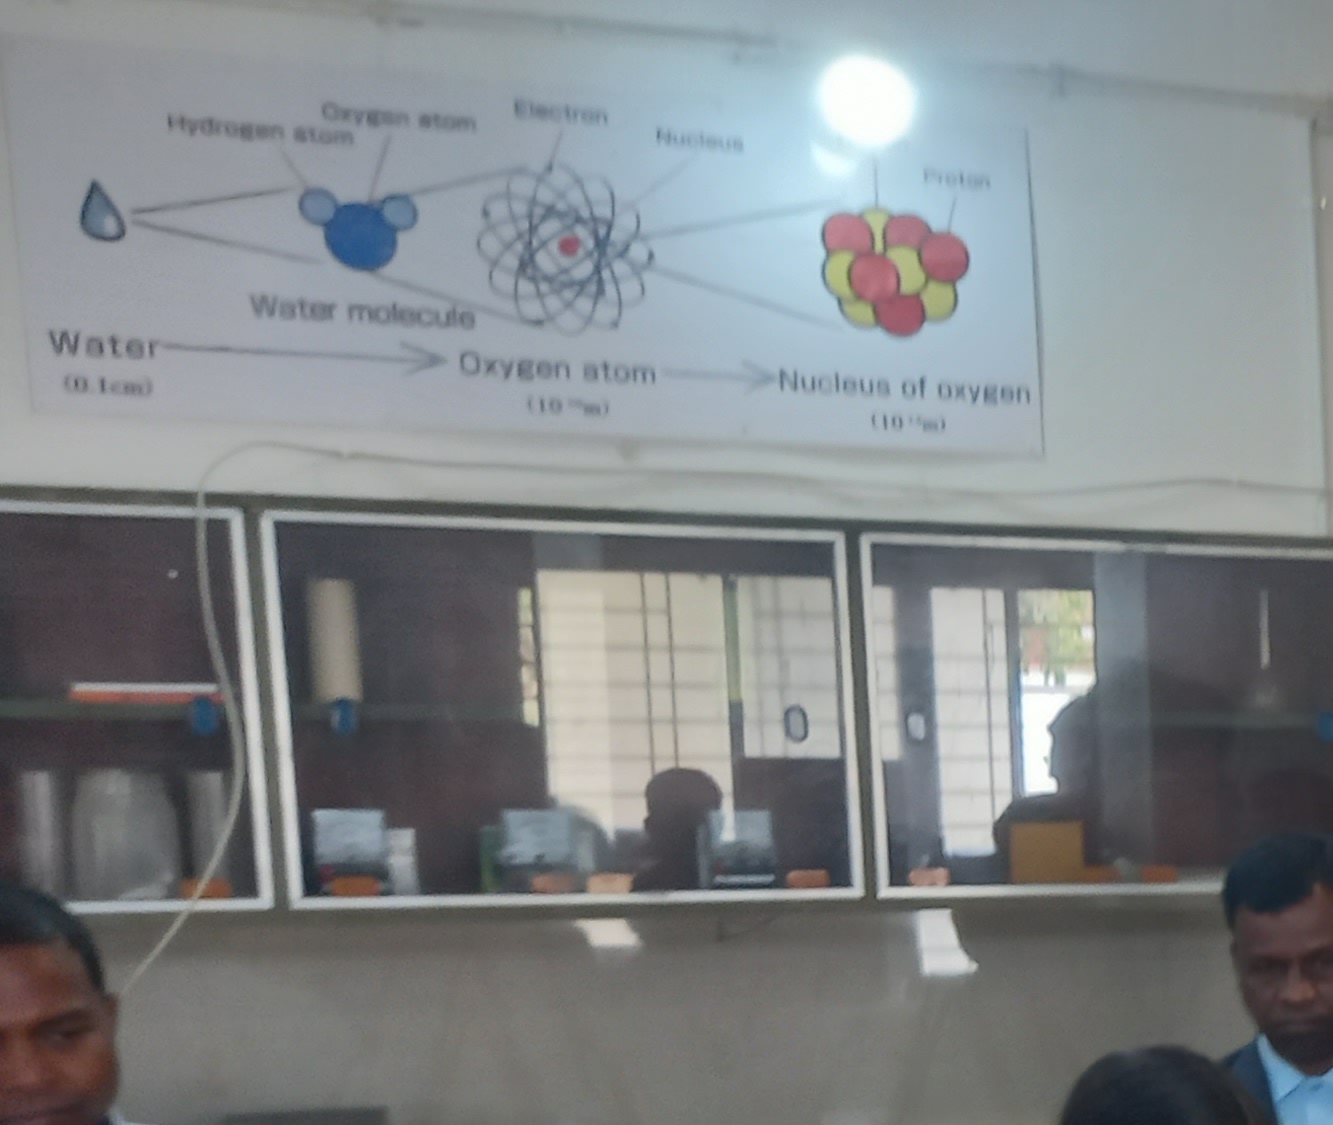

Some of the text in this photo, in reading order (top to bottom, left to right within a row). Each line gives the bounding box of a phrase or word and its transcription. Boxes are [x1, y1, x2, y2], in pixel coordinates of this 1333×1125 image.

[167, 112, 354, 145] Hydrogen atom
[321, 101, 476, 133] Oxygen atom
[514, 100, 608, 126] Electron
[656, 128, 744, 154] Nucleus
[922, 168, 991, 190] Proton
[250, 293, 475, 330] Water molecule
[49, 328, 158, 360] Water
[459, 350, 656, 384] Oxygen atom
[779, 368, 1031, 404] Nucleus of oxygen
